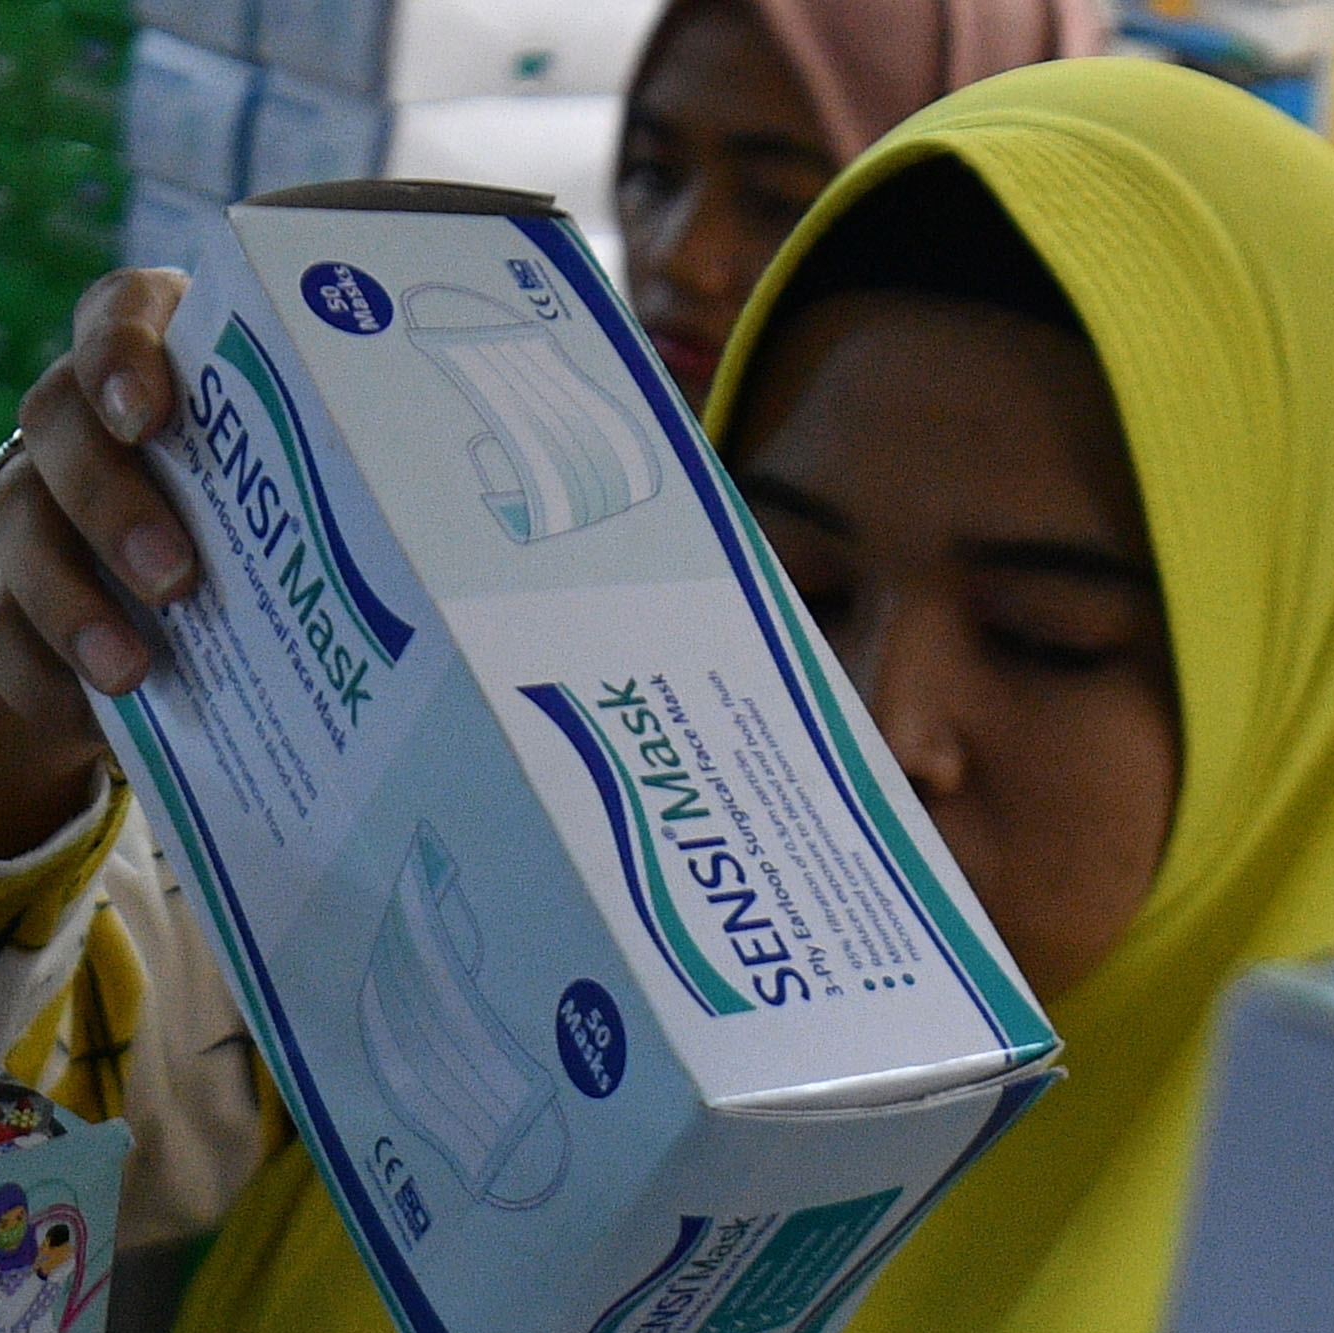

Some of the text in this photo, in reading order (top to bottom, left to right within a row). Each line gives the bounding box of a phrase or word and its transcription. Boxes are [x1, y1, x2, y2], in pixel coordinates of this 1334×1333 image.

[319, 285, 349, 313] 50
[333, 264, 380, 330] Masks
[188, 364, 373, 727] SENSI Mask
[202, 468, 243, 556] Earloop
[244, 553, 289, 643] Surgical
[287, 639, 314, 694] Face
[314, 691, 346, 756] Mask
[704, 668, 736, 709] fluids
[729, 710, 759, 748] body
[749, 747, 776, 779] and
[771, 748, 799, 785] from
[767, 778, 800, 822] blood
[597, 677, 811, 1007] SENSI Mask
[650, 673, 843, 997] 3-Ply Earloop Surgical Face Mask
[793, 821, 810, 838] to
[560, 999, 612, 1092] Masks
[585, 1007, 613, 1048] 50
[689, 1213, 759, 1281] Mask
